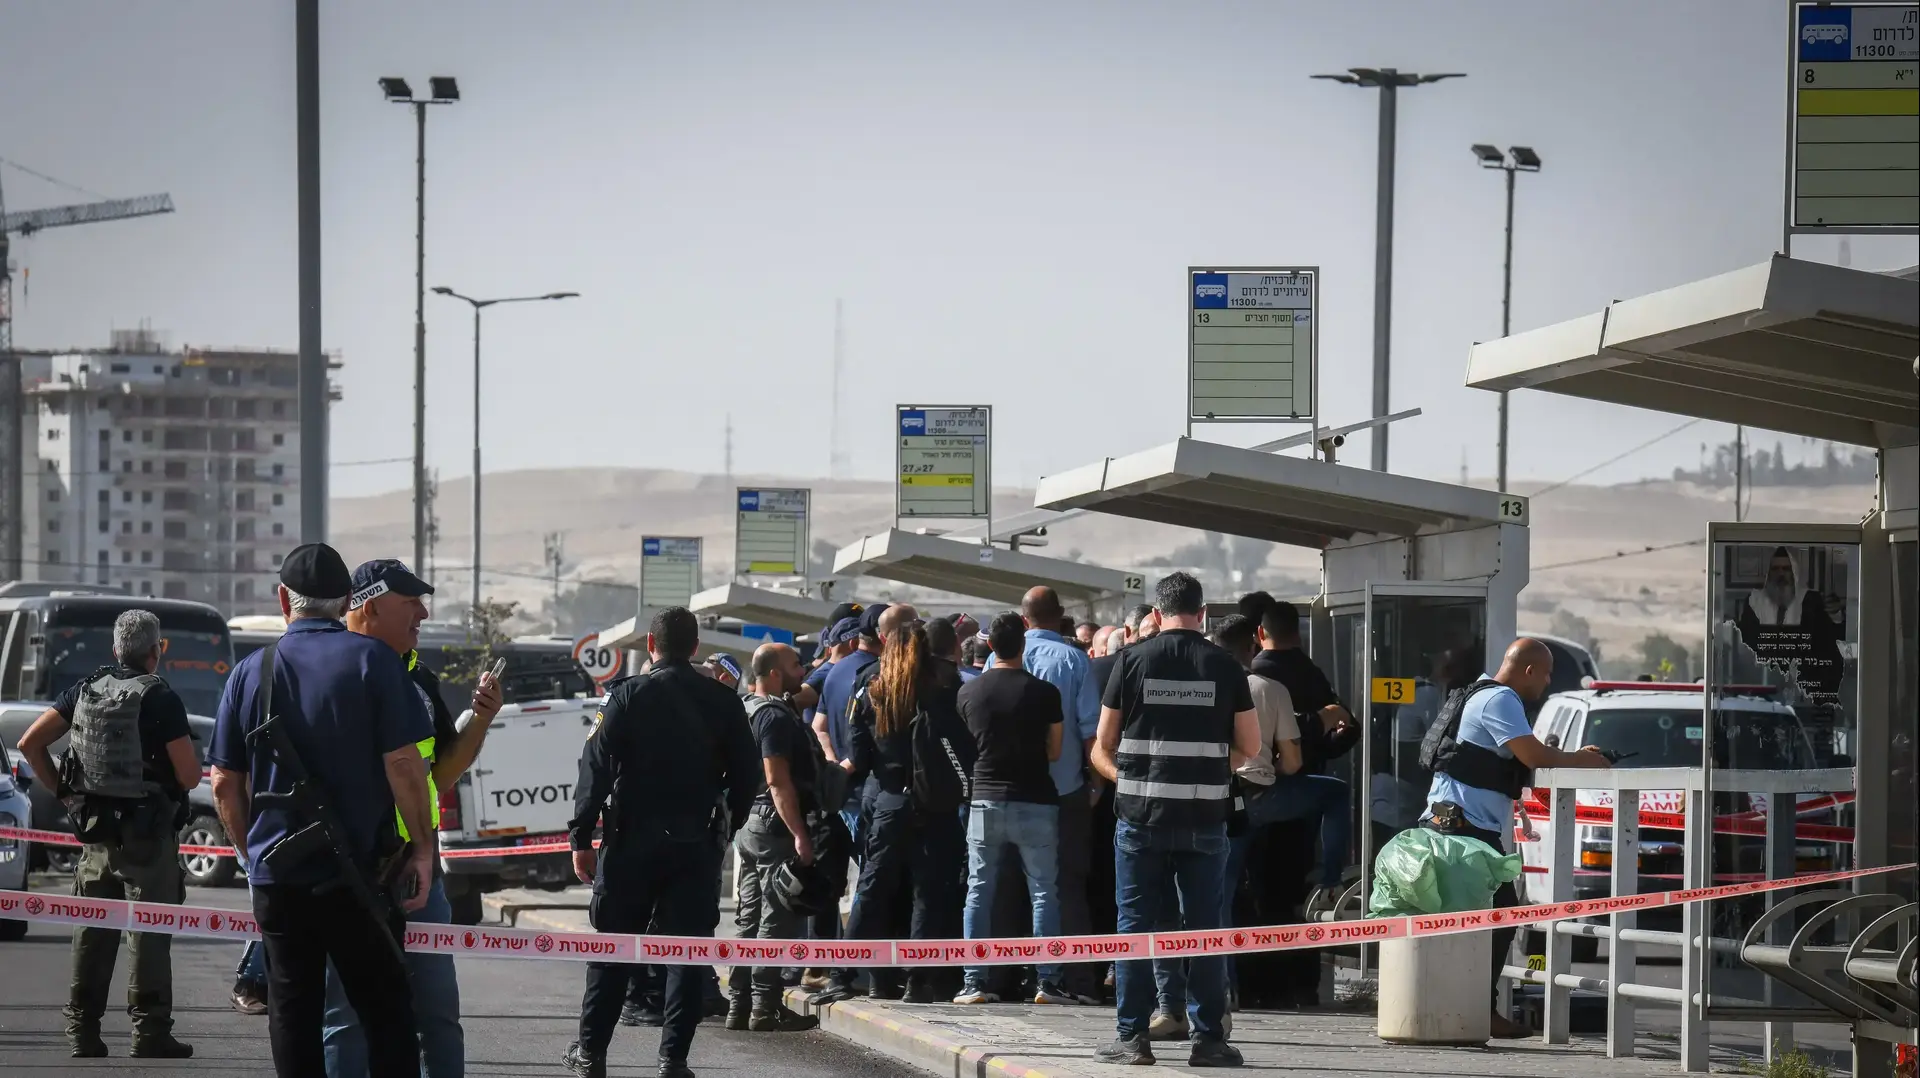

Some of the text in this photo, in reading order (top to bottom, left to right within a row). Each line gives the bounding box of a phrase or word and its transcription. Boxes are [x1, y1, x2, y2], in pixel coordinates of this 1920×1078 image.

[1873, 26, 1914, 41] לדרום
[1855, 45, 1895, 57] 11300
[1804, 69, 1815, 83] 8
[1242, 286, 1309, 296] עירוניים לדרום
[1230, 298, 1257, 306] 11300
[1197, 313, 1210, 323] 13
[1245, 314, 1269, 322] חצרים
[1272, 314, 1291, 323] מסוף
[1500, 500, 1522, 517] 13
[1125, 577, 1141, 589] 12
[351, 584, 383, 605] משטרה
[583, 649, 611, 668] 30
[1146, 688, 1213, 699] מנהל אגף הביטחון
[1383, 681, 1403, 700] 13
[940, 738, 968, 797] SKECHERS
[491, 783, 576, 808] TOYOT
[1674, 888, 1715, 901] מעבר
[1719, 885, 1740, 898] אין
[49, 903, 107, 919] משטרת
[134, 910, 175, 925] מעבר
[1415, 896, 1646, 930] משטרת ישראל אין מעבר
[179, 916, 200, 931] אין
[404, 931, 616, 954] משטרת ישראל אין מע
[1157, 924, 1387, 951] משטרת ישראל אין מעבר
[643, 943, 872, 959] משטרת ישראל אין מעבר
[899, 941, 1130, 961] משטרת ישראל אין מעבר
[1528, 958, 1542, 970] 20
